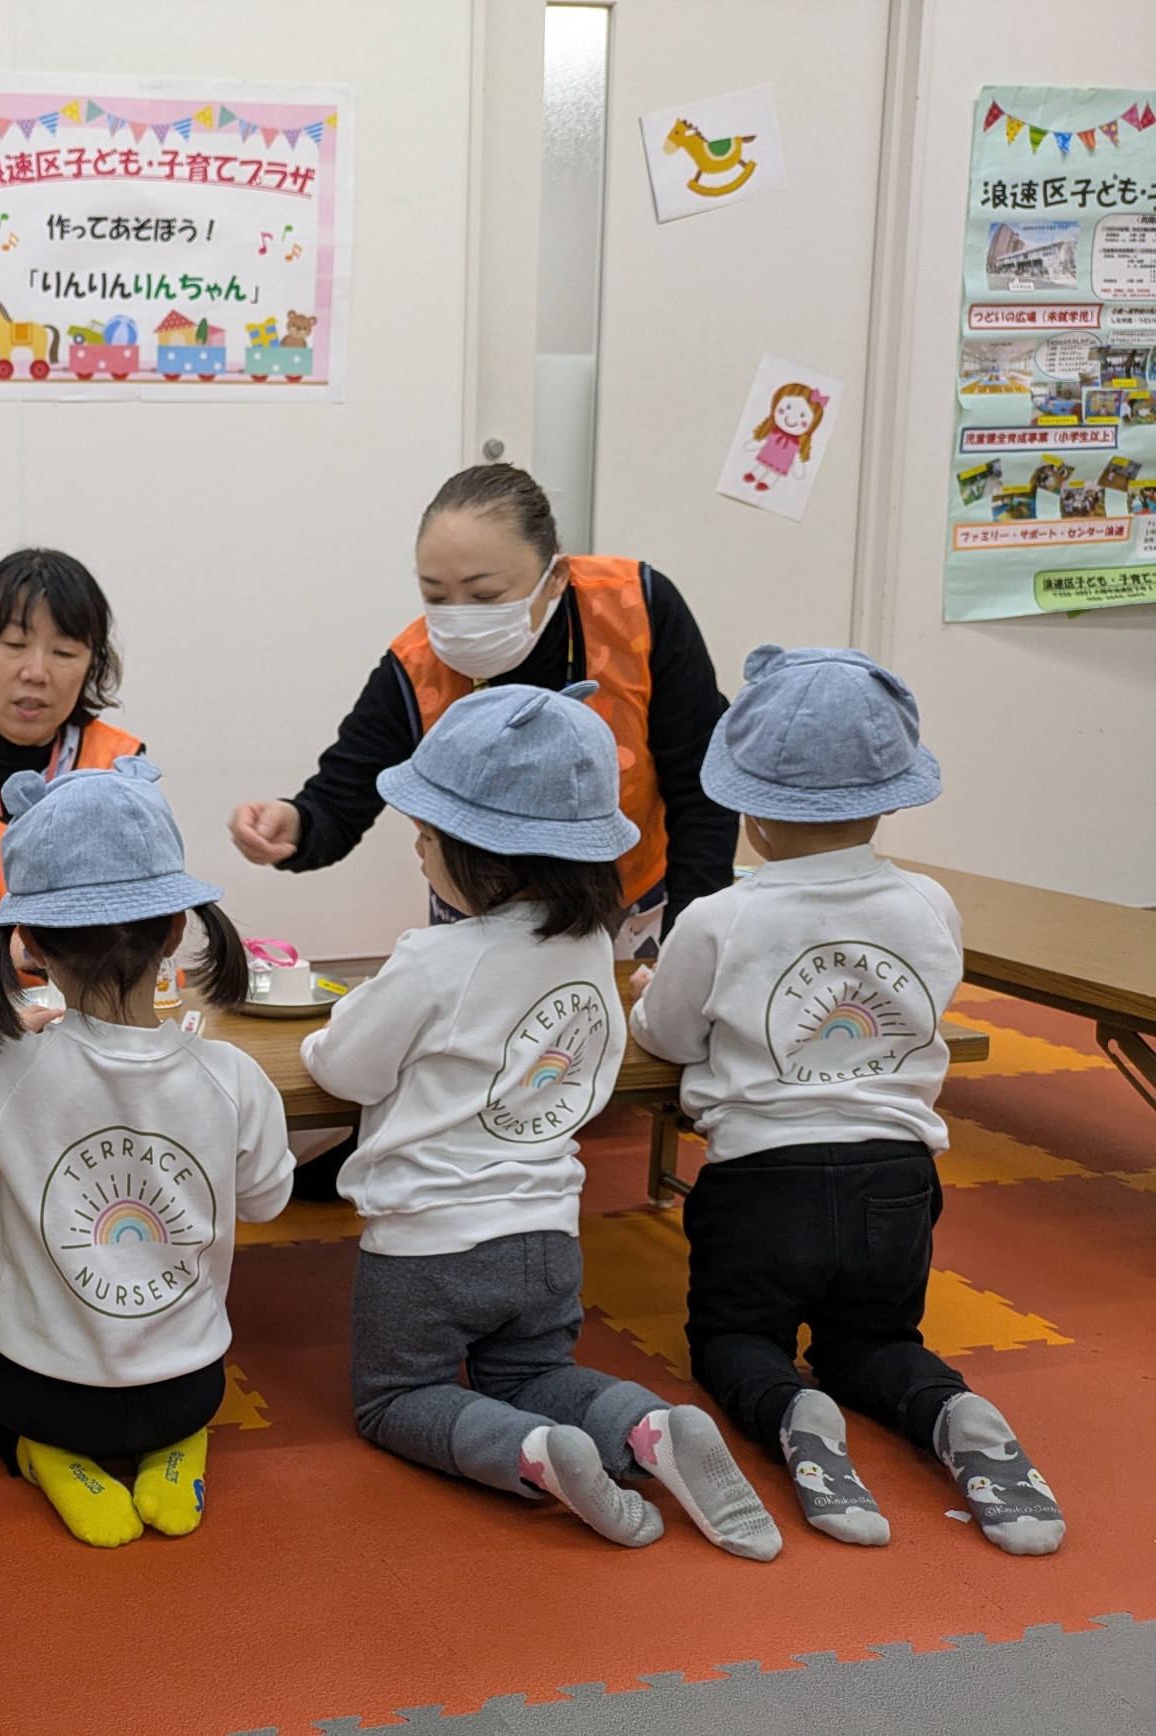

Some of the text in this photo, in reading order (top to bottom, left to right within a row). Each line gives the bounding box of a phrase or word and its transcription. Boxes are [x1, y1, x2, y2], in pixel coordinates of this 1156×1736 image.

[29, 268, 260, 304] 「りんりんりんちゃん」
[785, 952, 909, 1000] TERRACE
[64, 1138, 193, 1185] TERRACE
[75, 1260, 191, 1306] NURSERY
